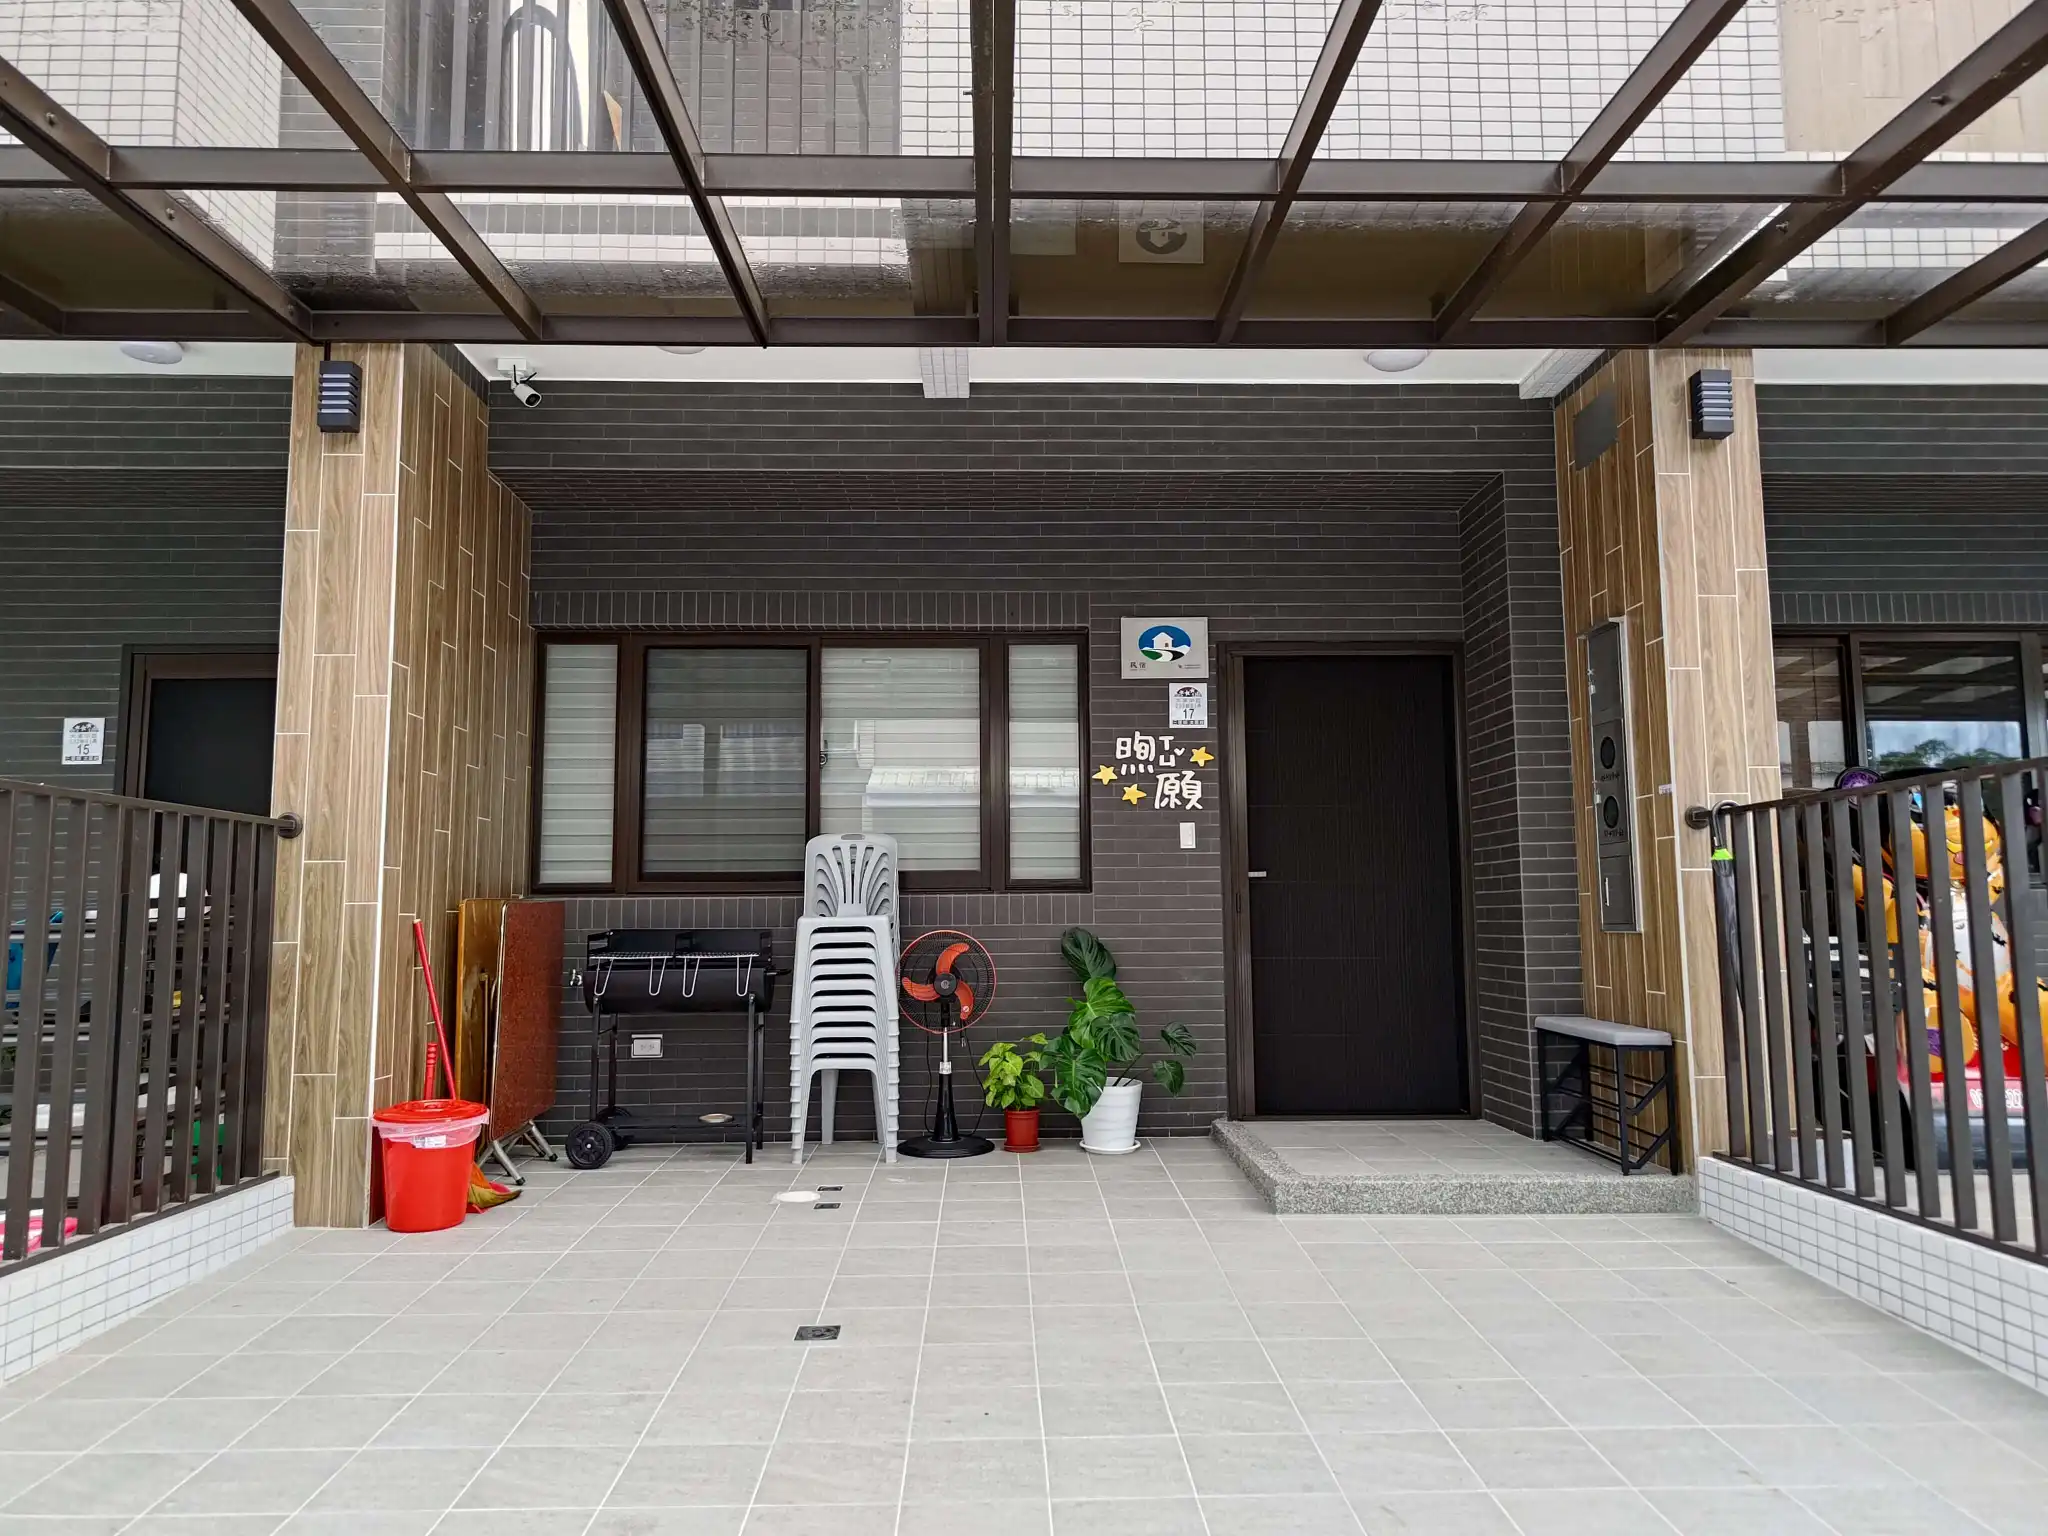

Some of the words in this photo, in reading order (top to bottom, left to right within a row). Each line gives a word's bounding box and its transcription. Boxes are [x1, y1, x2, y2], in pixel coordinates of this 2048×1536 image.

[1183, 708, 1195, 719] 17
[77, 743, 90, 755] 15
[1154, 770, 1204, 810] 願
